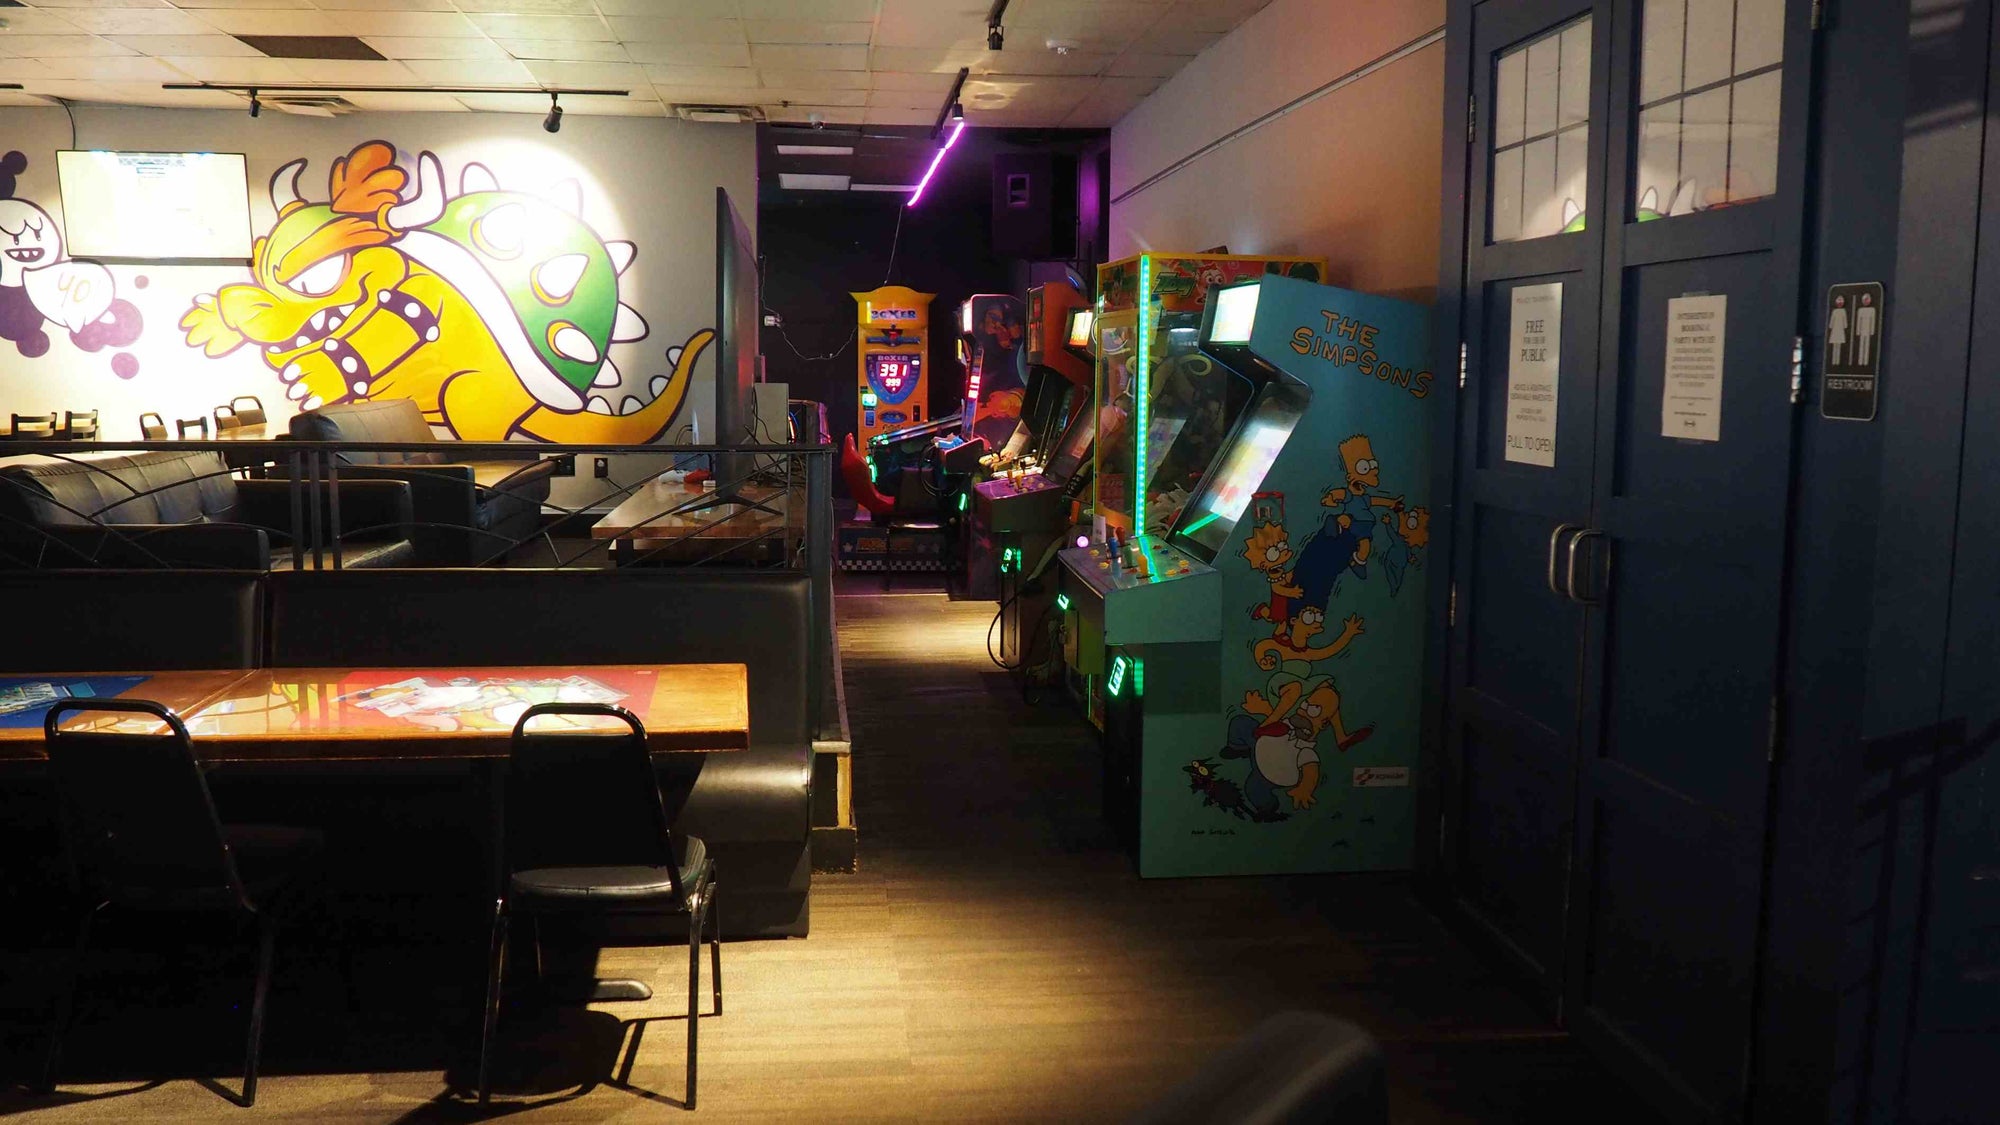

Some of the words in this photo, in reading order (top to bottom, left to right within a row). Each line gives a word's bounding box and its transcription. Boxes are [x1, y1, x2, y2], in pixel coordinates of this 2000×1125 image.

[1321, 309, 1380, 348] THE
[1525, 320, 1544, 333] FREE
[1521, 349, 1547, 362] PUBLIC
[1290, 326, 1434, 399] SIMPSONS
[880, 364, 908, 376] 391
[1828, 379, 1872, 390] RESTROOM
[1508, 435, 1523, 449] PULL
[1524, 436, 1534, 450] TO
[1535, 437, 1554, 452] OPEN
